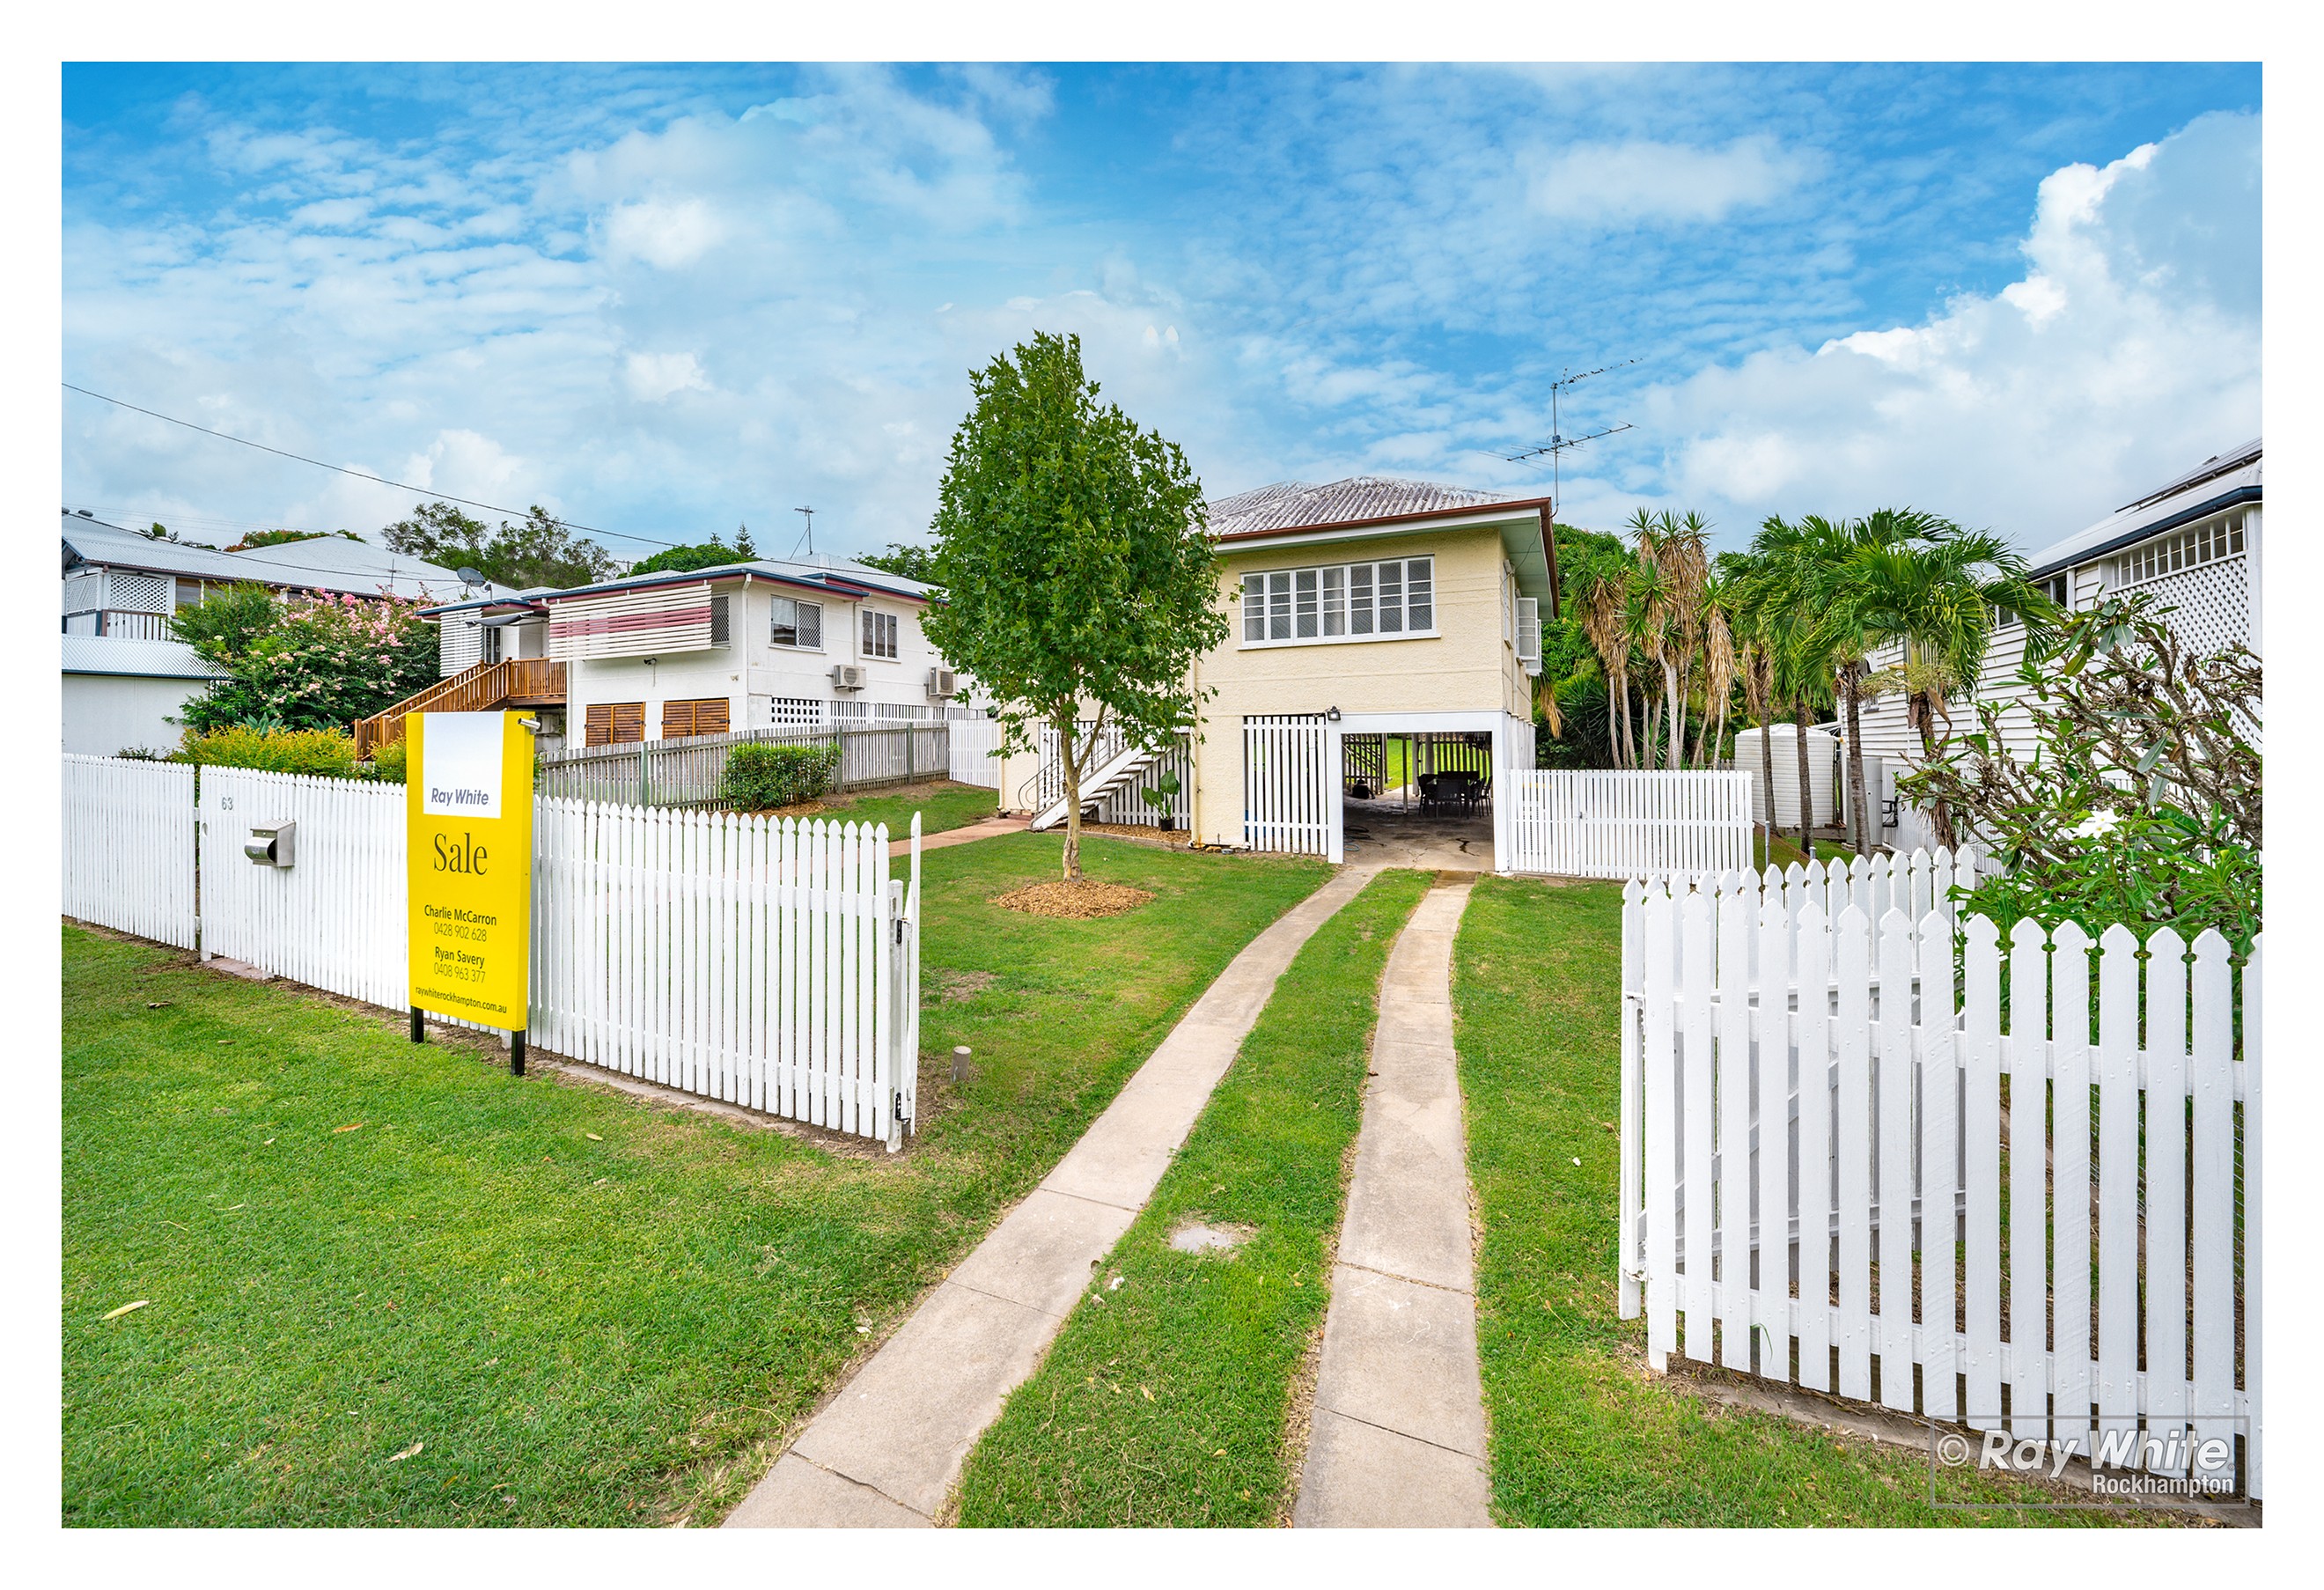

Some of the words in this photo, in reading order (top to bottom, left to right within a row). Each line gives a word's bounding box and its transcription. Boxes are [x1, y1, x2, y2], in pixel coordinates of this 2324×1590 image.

[222, 797, 233, 810] 63
[431, 788, 453, 806] Ray
[455, 789, 489, 806] White
[433, 832, 488, 875] Sale
[424, 904, 452, 919] Charlie
[454, 909, 496, 925] McCarron
[433, 922, 452, 937] 0428
[454, 924, 469, 939] 902
[471, 927, 487, 942] 628
[435, 946, 454, 961] Ryan
[457, 950, 485, 969] Savery
[433, 962, 452, 977] 0408
[454, 966, 469, 981] 963
[471, 968, 485, 983] 377
[416, 986, 507, 1013] raywhiterockhampton.com.au
